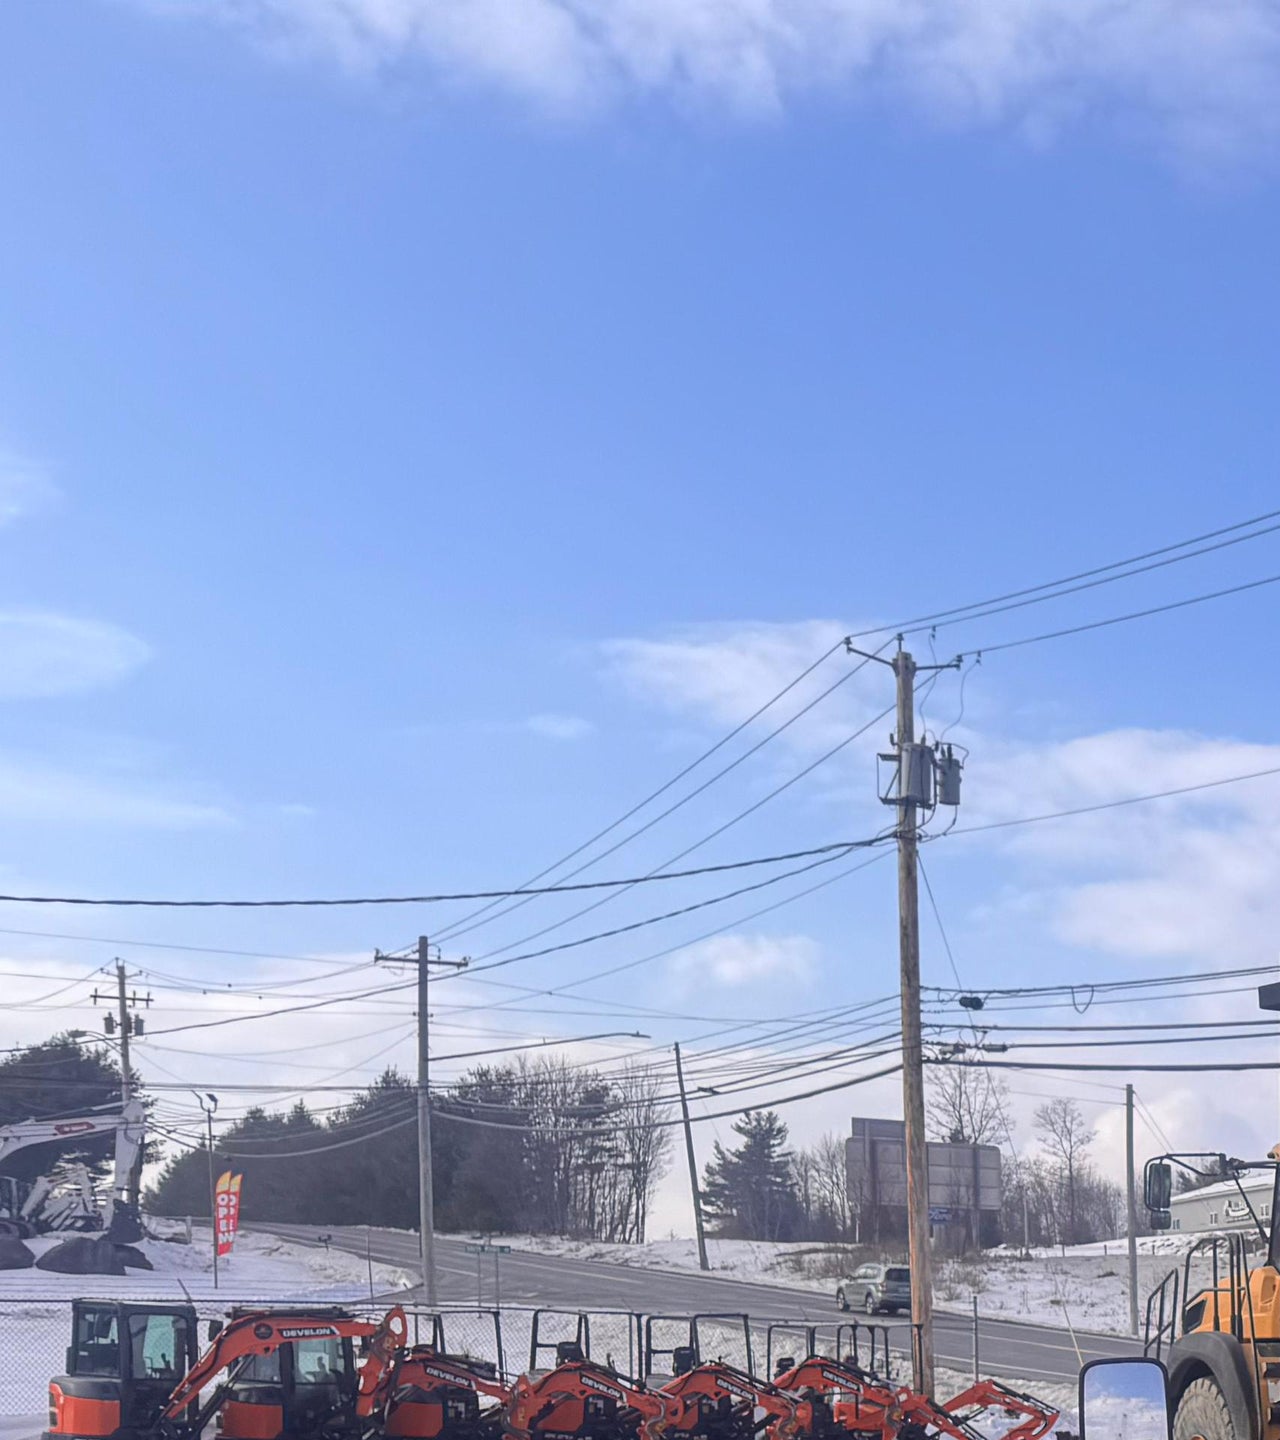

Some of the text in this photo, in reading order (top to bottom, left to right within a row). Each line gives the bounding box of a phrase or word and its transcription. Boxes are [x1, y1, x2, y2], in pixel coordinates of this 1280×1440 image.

[283, 1327, 331, 1338] DEVELON
[426, 1366, 469, 1386] DEVELON
[823, 1370, 859, 1391] DEVELON
[581, 1377, 621, 1399] DEVELON
[717, 1378, 754, 1400] DEVELON
